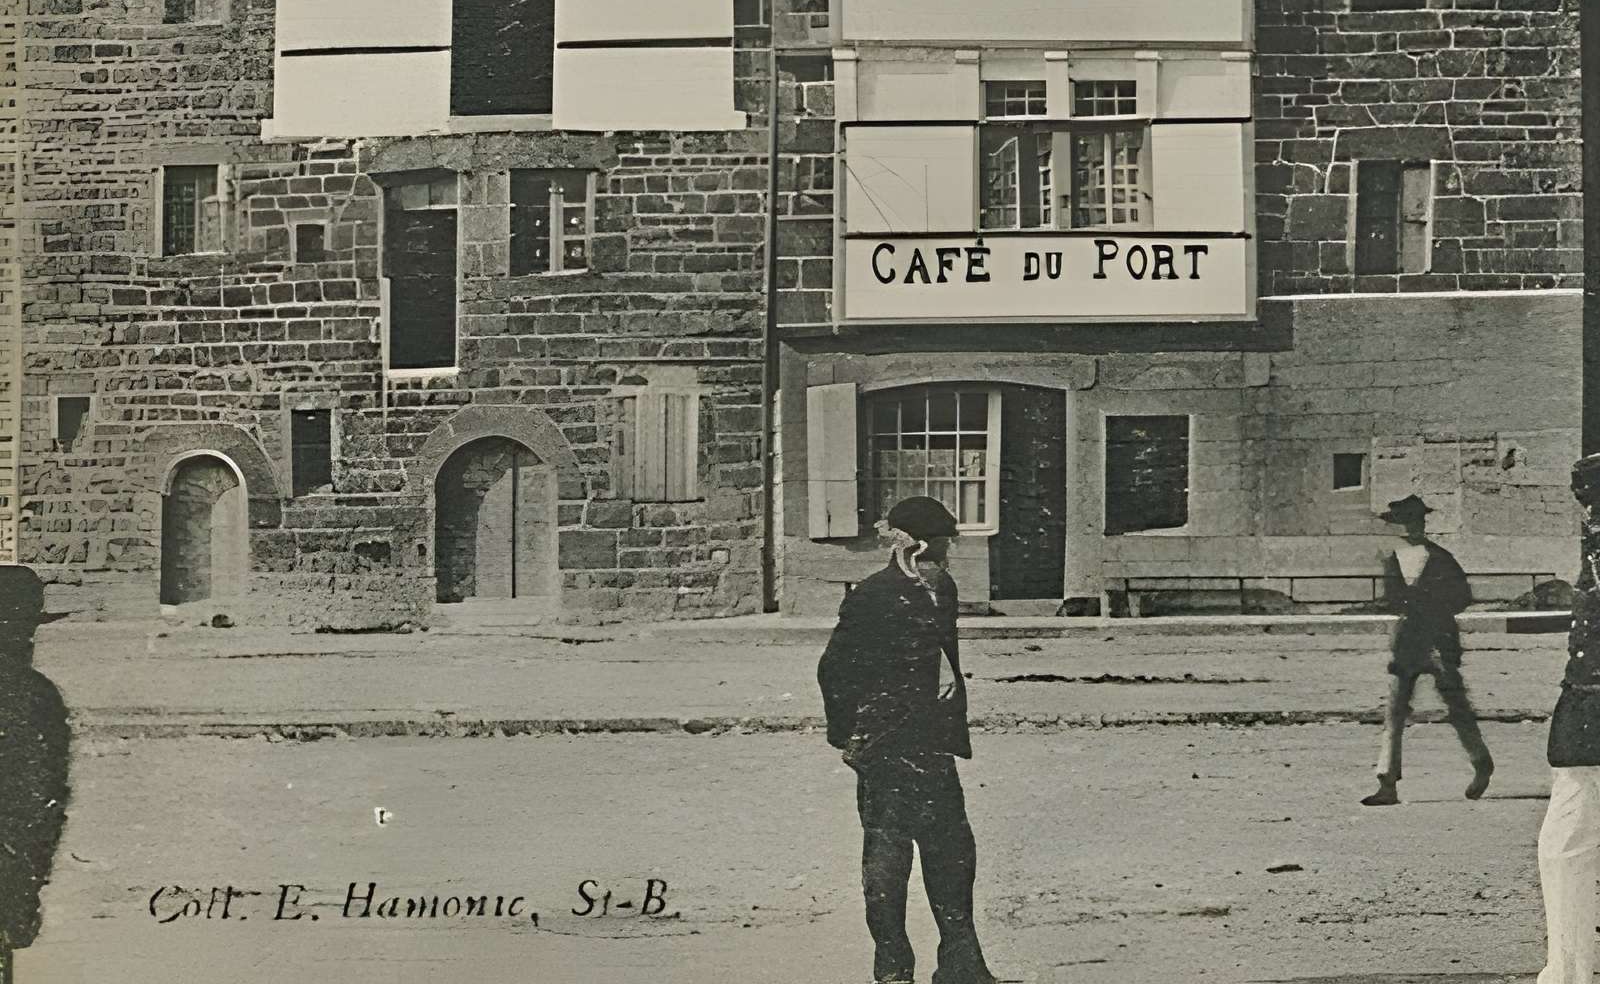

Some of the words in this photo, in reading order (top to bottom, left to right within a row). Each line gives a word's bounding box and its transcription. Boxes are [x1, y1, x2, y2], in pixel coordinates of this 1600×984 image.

[871, 237, 991, 285] CAFÉ
[1022, 251, 1063, 282] DU
[1092, 238, 1209, 281] PORT
